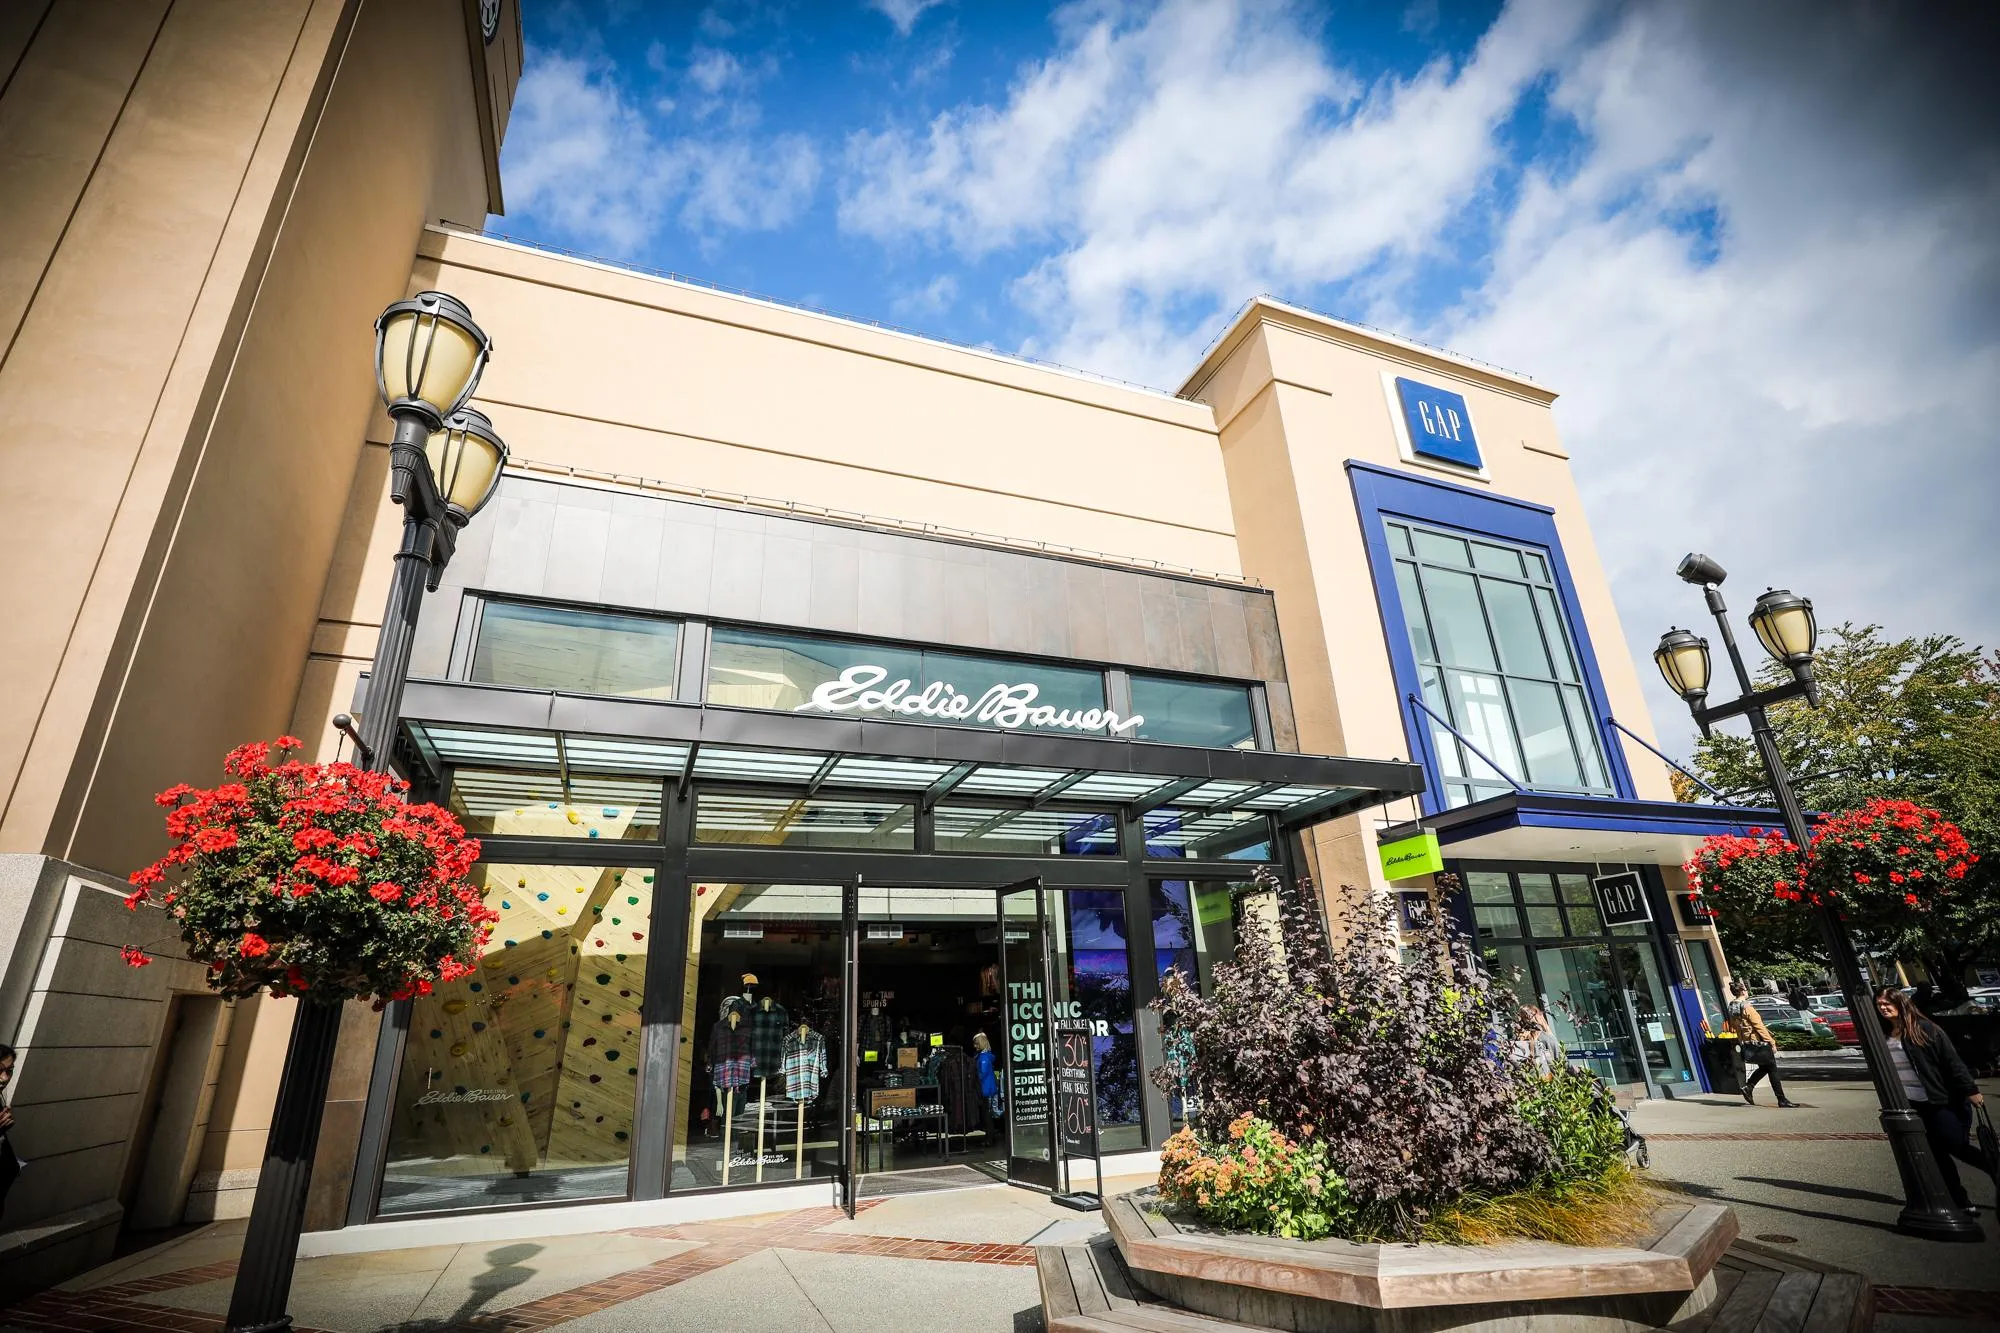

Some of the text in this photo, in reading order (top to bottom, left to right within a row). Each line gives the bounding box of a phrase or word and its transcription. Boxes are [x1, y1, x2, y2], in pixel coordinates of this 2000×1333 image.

[1418, 400, 1462, 442] GAP
[793, 664, 1145, 734] Eddie Bauer
[1602, 884, 1637, 915] GAP
[1014, 1075, 1044, 1086] EDDIE
[411, 1089, 514, 1107] Eddie Bauer
[1015, 1086, 1048, 1097] FLANN
[1015, 1113, 1047, 1121] Guaranteed
[728, 1155, 789, 1168] Eddie Bauer
